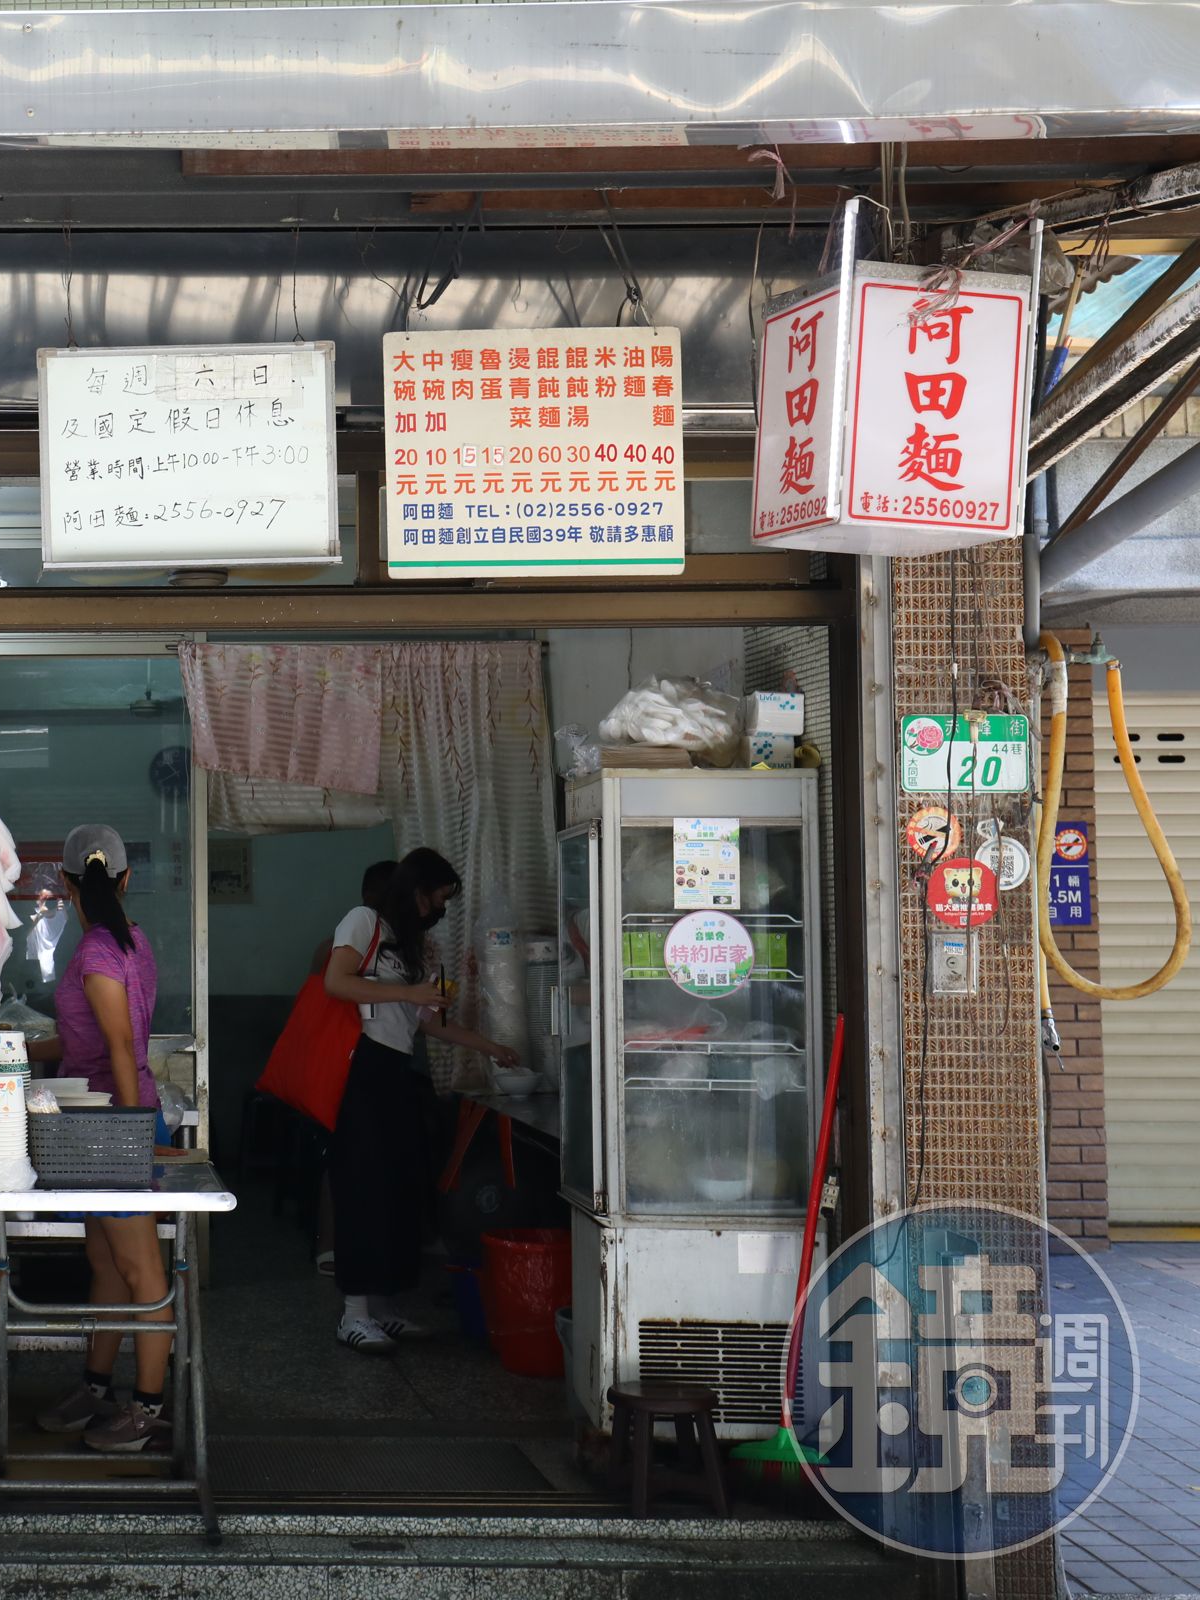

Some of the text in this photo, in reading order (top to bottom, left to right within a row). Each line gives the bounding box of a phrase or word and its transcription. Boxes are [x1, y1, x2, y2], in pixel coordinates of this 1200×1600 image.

[779, 310, 824, 495] 阿田麵
[898, 298, 974, 492] 阿田麵
[61, 397, 295, 439] 及國定假日休息
[403, 503, 454, 520] 阿田麵
[759, 498, 828, 531] 電話:2556092
[860, 492, 1000, 522] 電話:25560927
[590, 524, 674, 544] 敬請多惠顧
[957, 756, 1002, 787] 20
[670, 945, 748, 963] 特約店家
